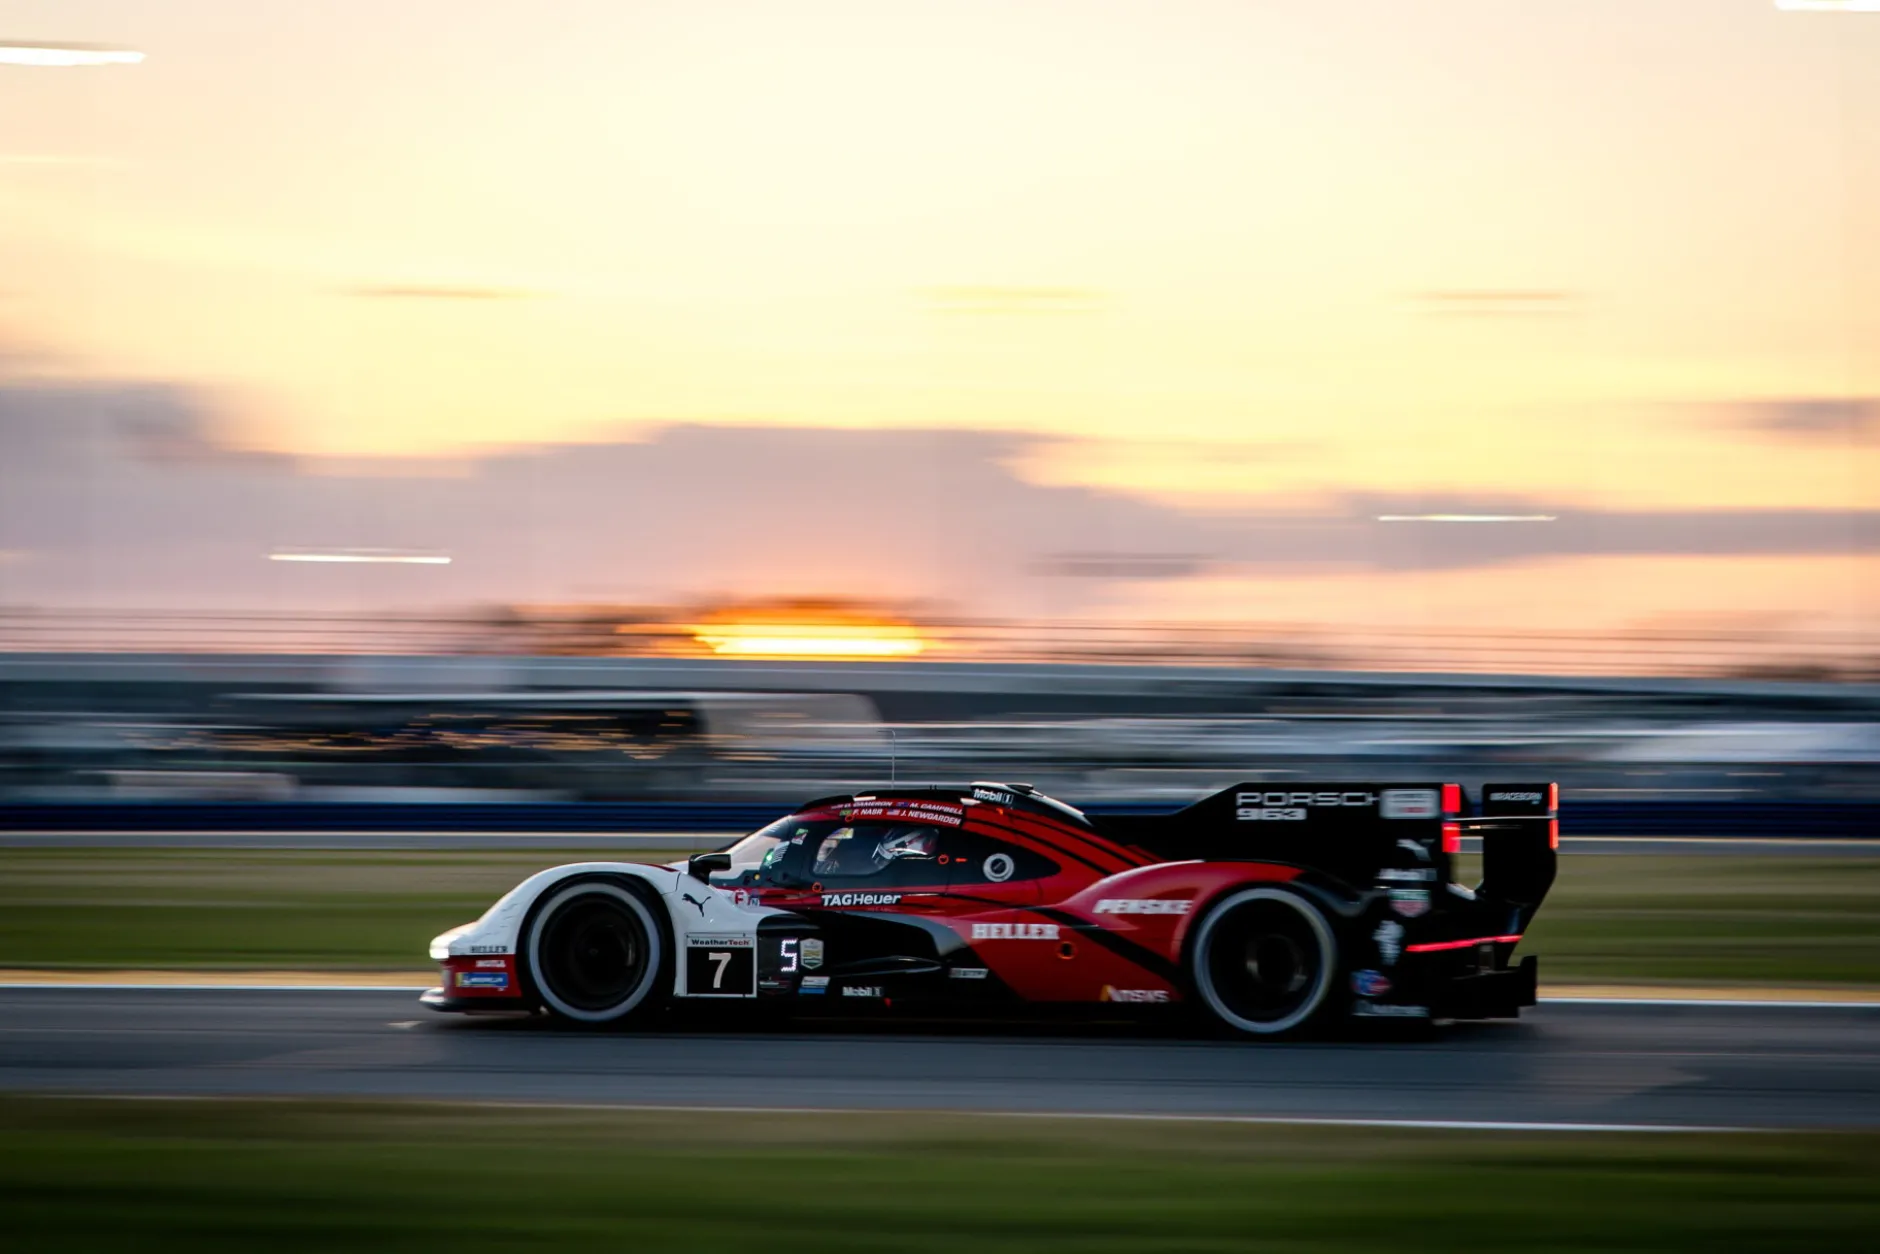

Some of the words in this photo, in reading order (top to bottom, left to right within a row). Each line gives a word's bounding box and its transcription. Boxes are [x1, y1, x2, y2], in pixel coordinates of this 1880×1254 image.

[973, 788, 1003, 803] Mobil
[861, 808, 882, 816] NASR
[908, 811, 961, 826] NEWGARDEN
[920, 804, 963, 815] CAMPBELL
[1235, 808, 1307, 820] 963
[971, 923, 1060, 939] HELLER
[780, 938, 799, 973] 5
[708, 952, 732, 989] 7
[842, 985, 873, 997] Mobil
